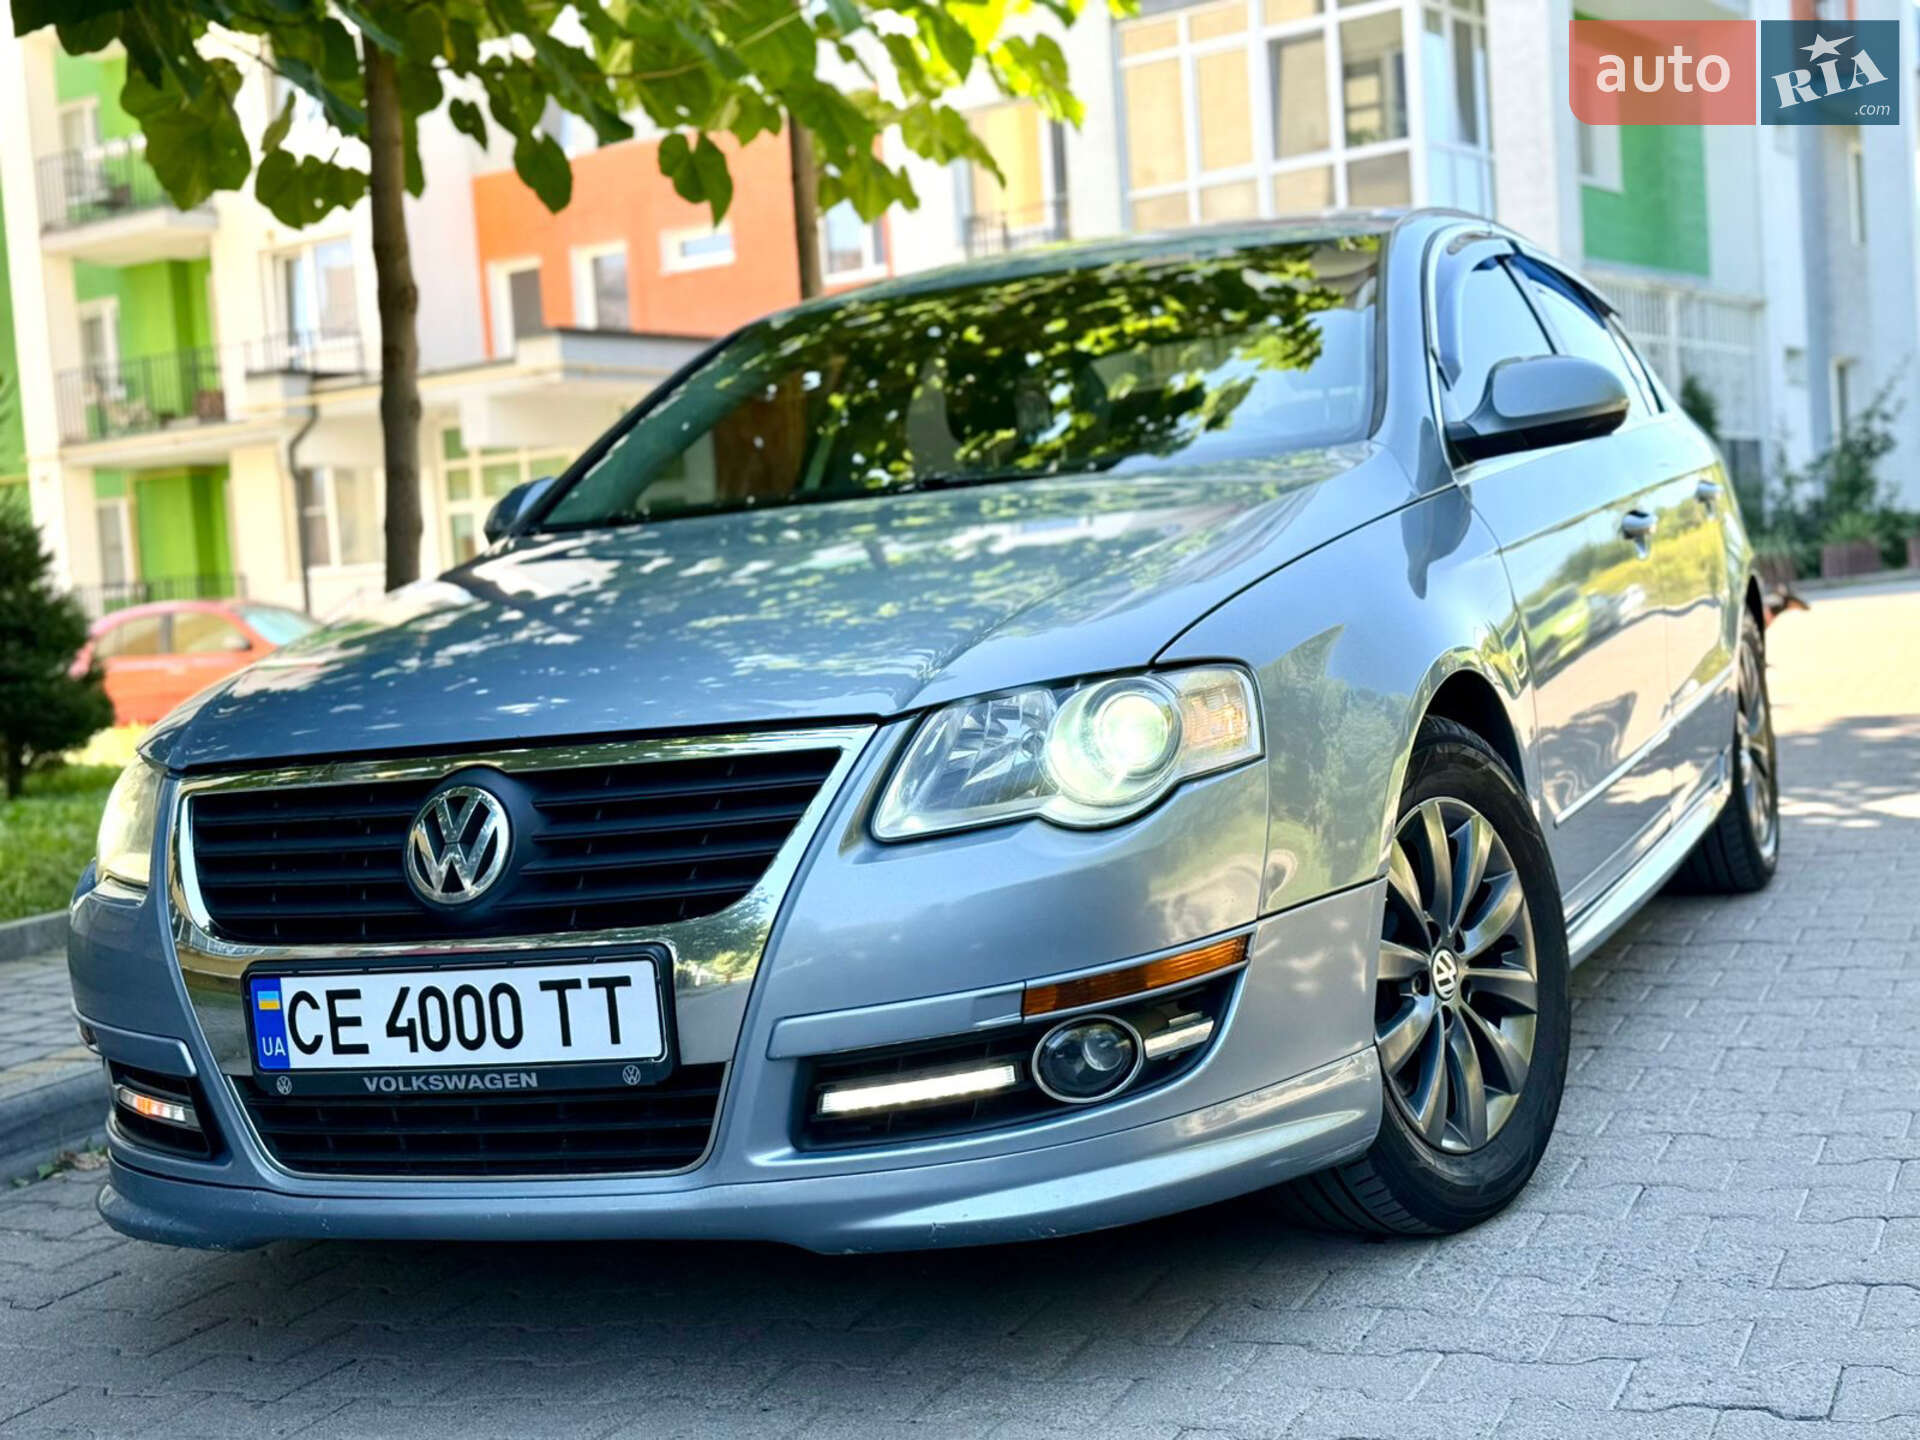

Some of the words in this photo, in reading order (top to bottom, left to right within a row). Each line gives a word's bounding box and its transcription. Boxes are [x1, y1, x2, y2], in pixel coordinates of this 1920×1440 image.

[288, 988, 369, 1055] CE
[386, 984, 524, 1053] 4000
[539, 975, 632, 1047] TT
[262, 1036, 286, 1056] UA
[363, 1072, 538, 1093] VOLKSWAGEN
